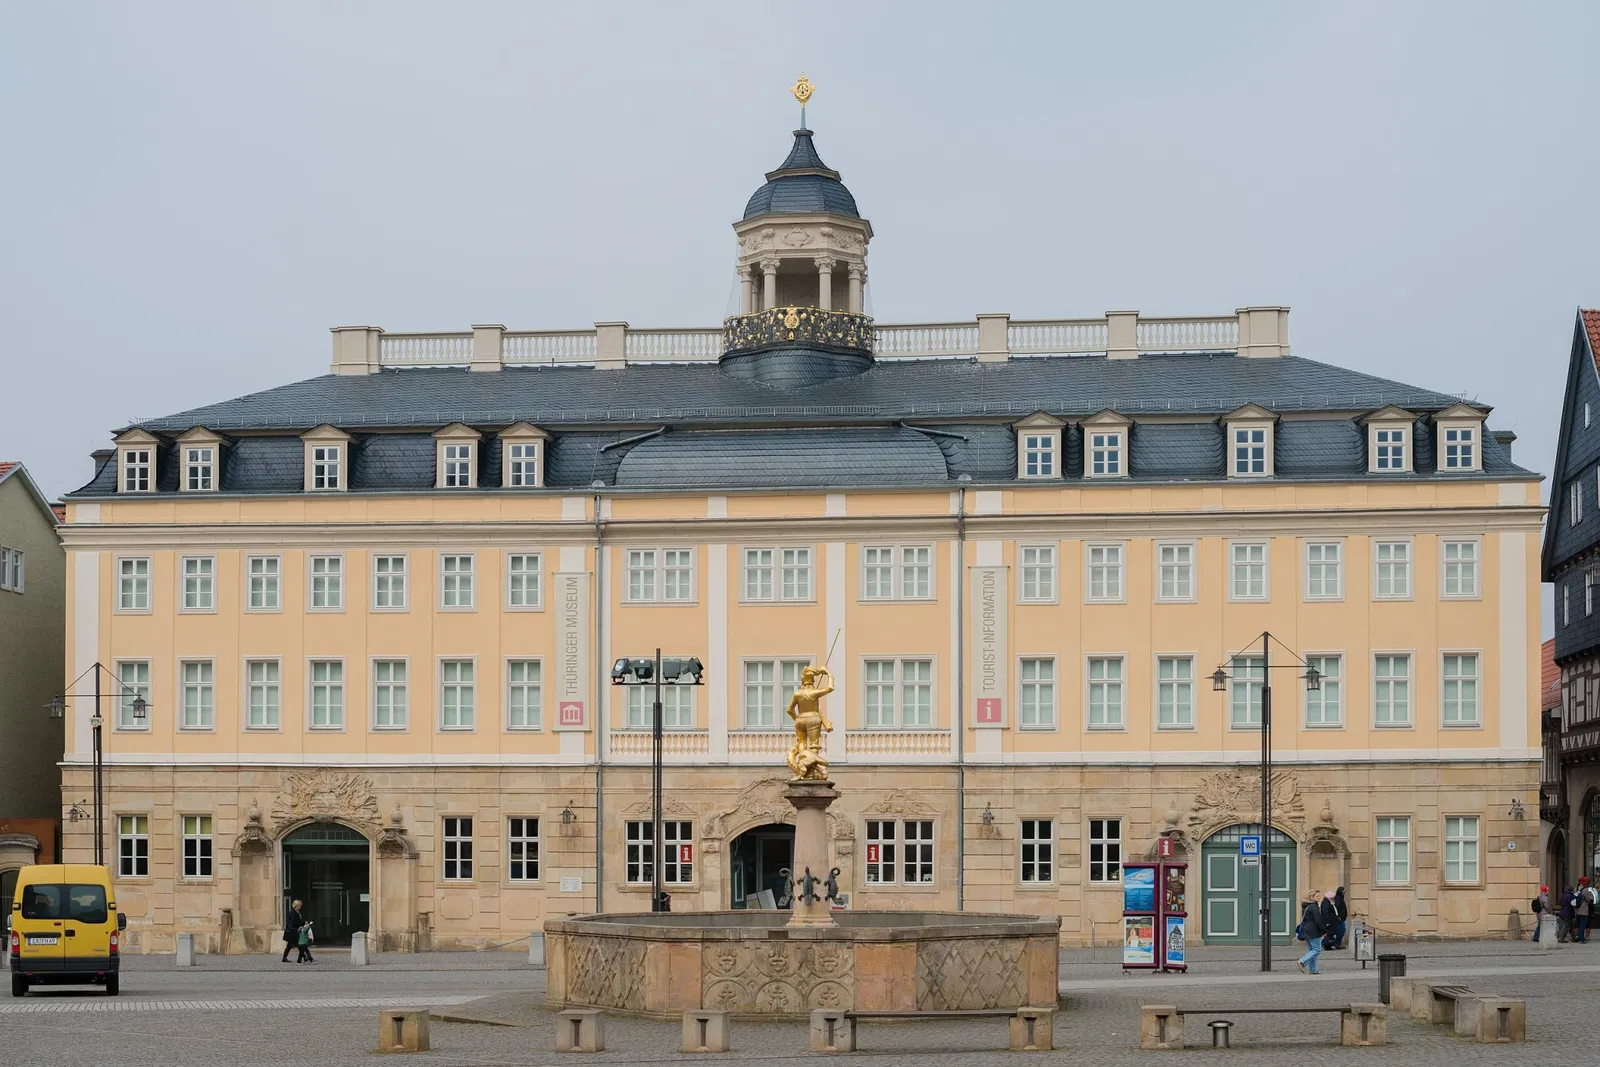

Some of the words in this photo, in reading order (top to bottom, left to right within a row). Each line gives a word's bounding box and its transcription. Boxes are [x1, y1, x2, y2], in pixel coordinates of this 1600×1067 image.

[565, 576, 578, 628] MUSEUM
[982, 571, 996, 693] TOURIST-INFORMATION
[563, 631, 578, 696] THÜRINGER
